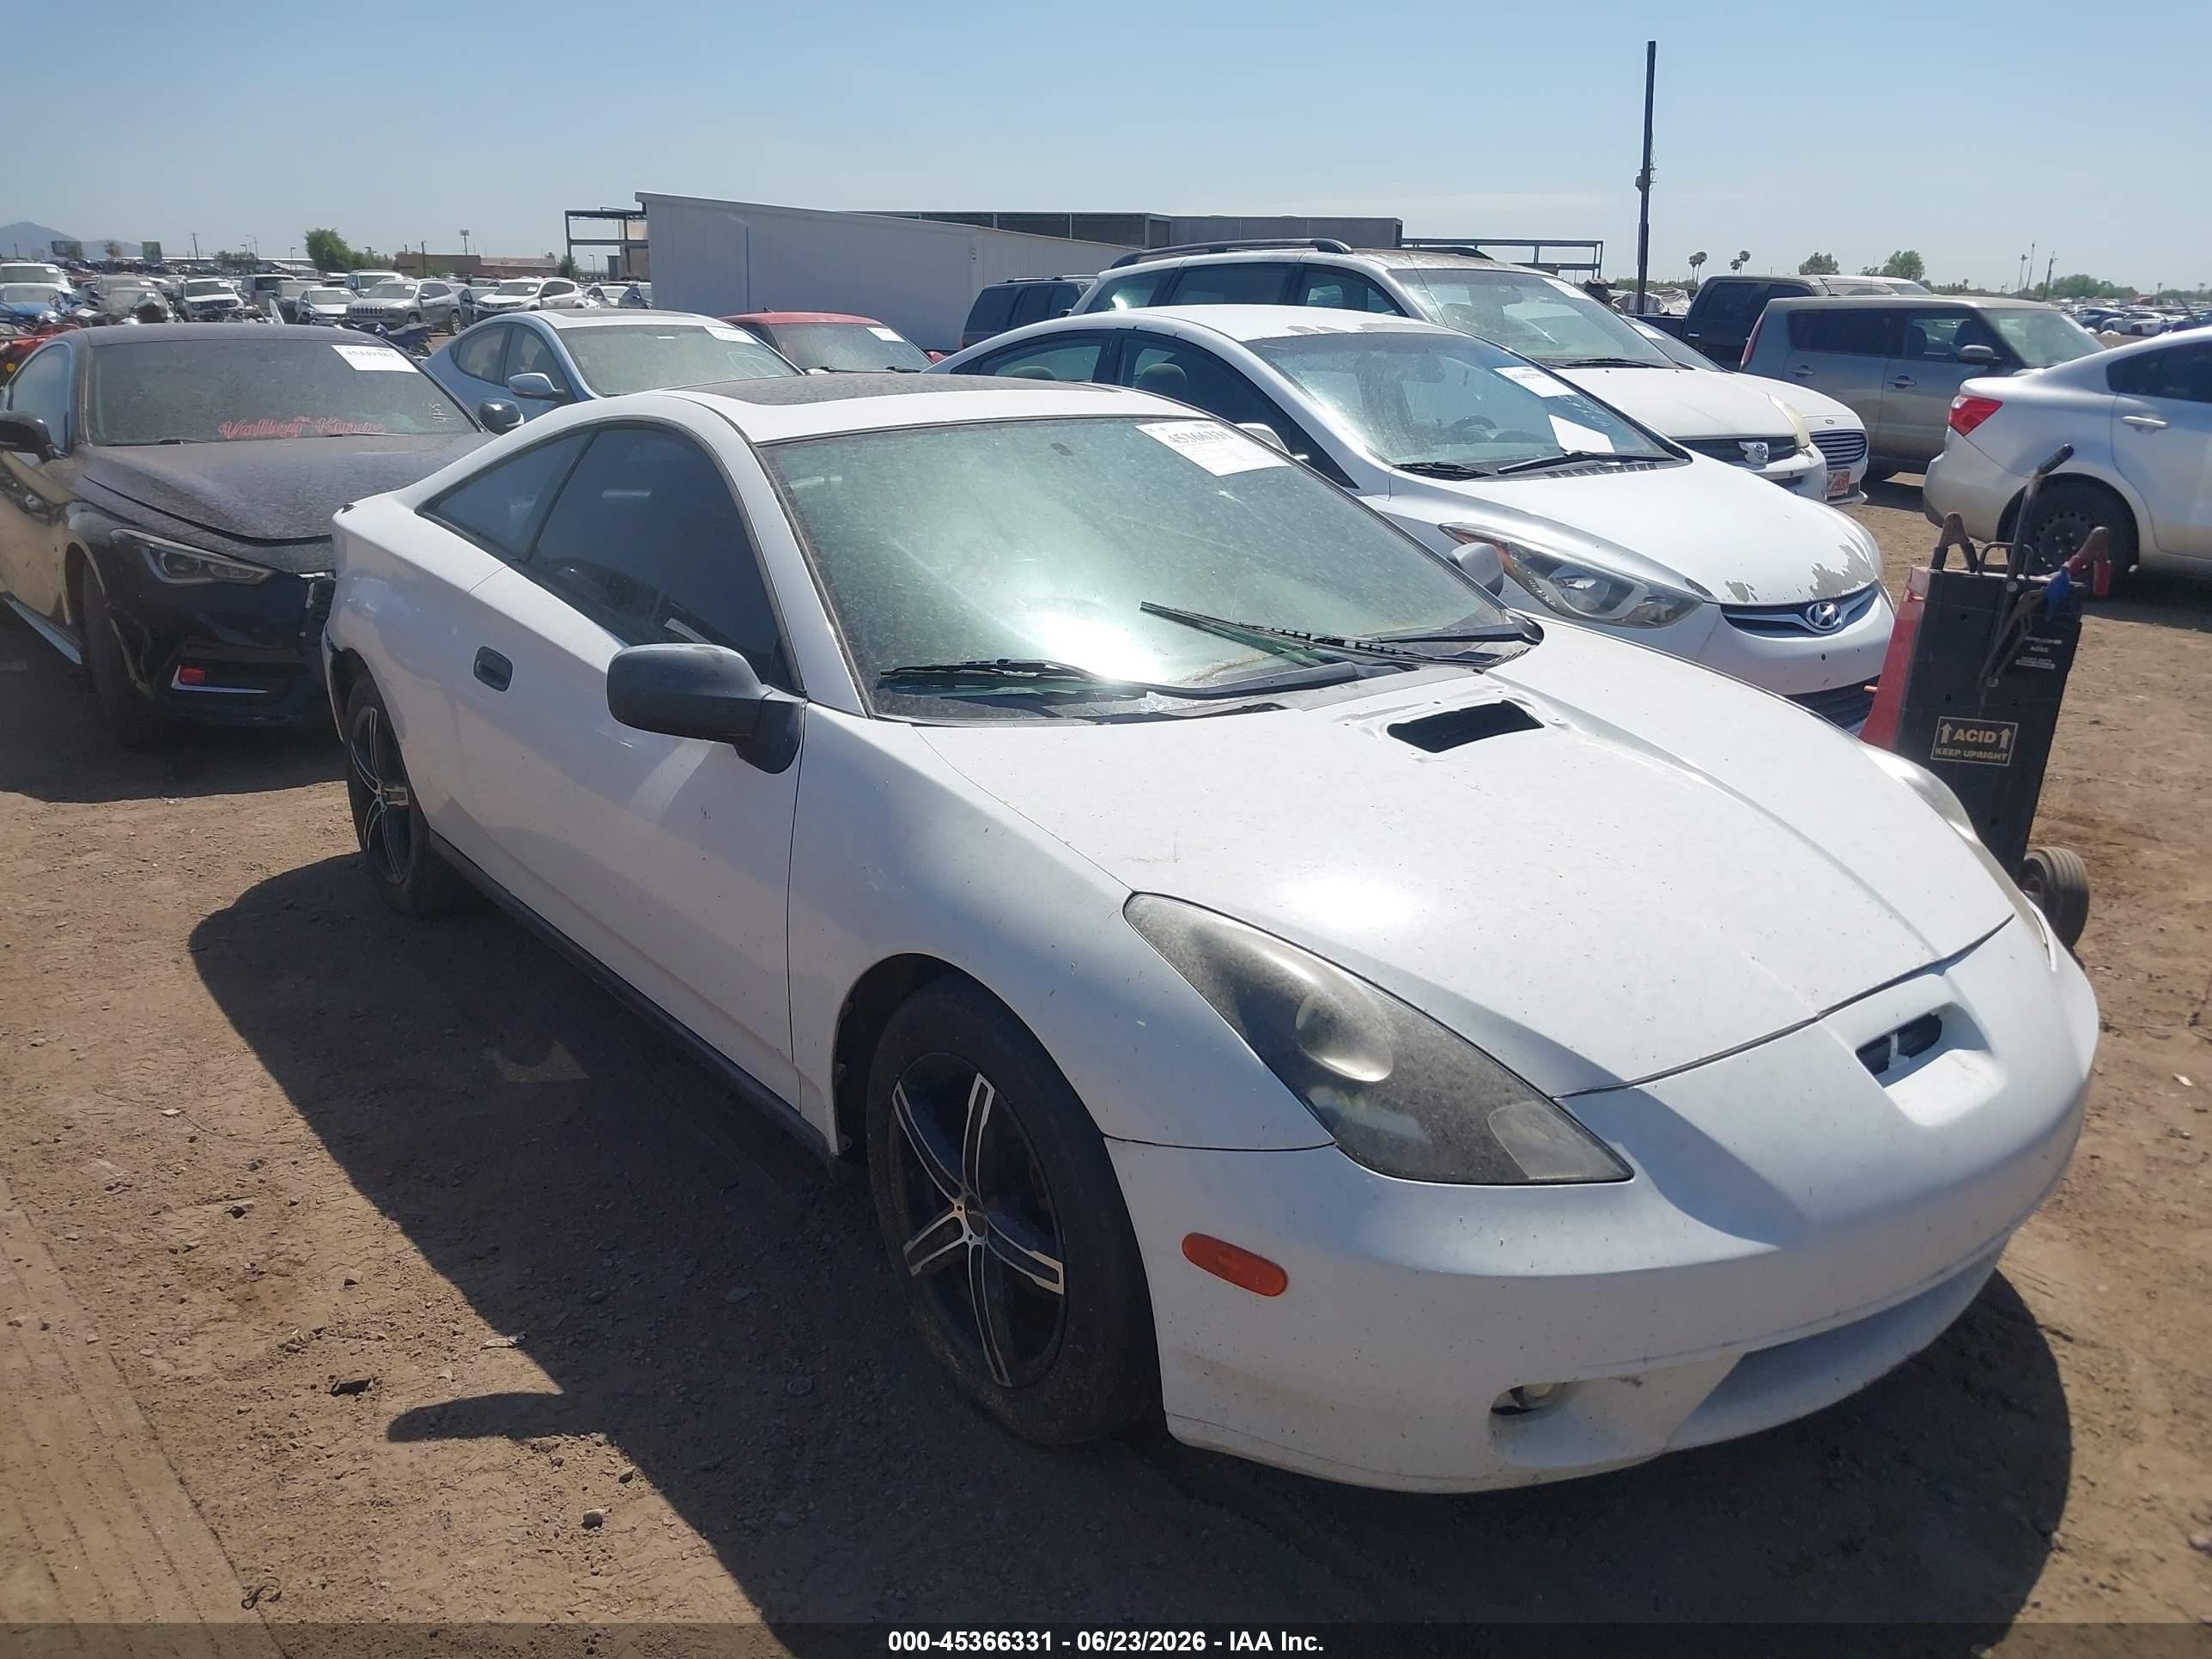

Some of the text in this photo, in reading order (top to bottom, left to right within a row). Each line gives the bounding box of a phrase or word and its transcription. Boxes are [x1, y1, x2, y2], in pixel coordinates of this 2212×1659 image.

[1953, 728, 1997, 744] ACID
[1935, 747, 2008, 761] KEEP UPRIGHT
